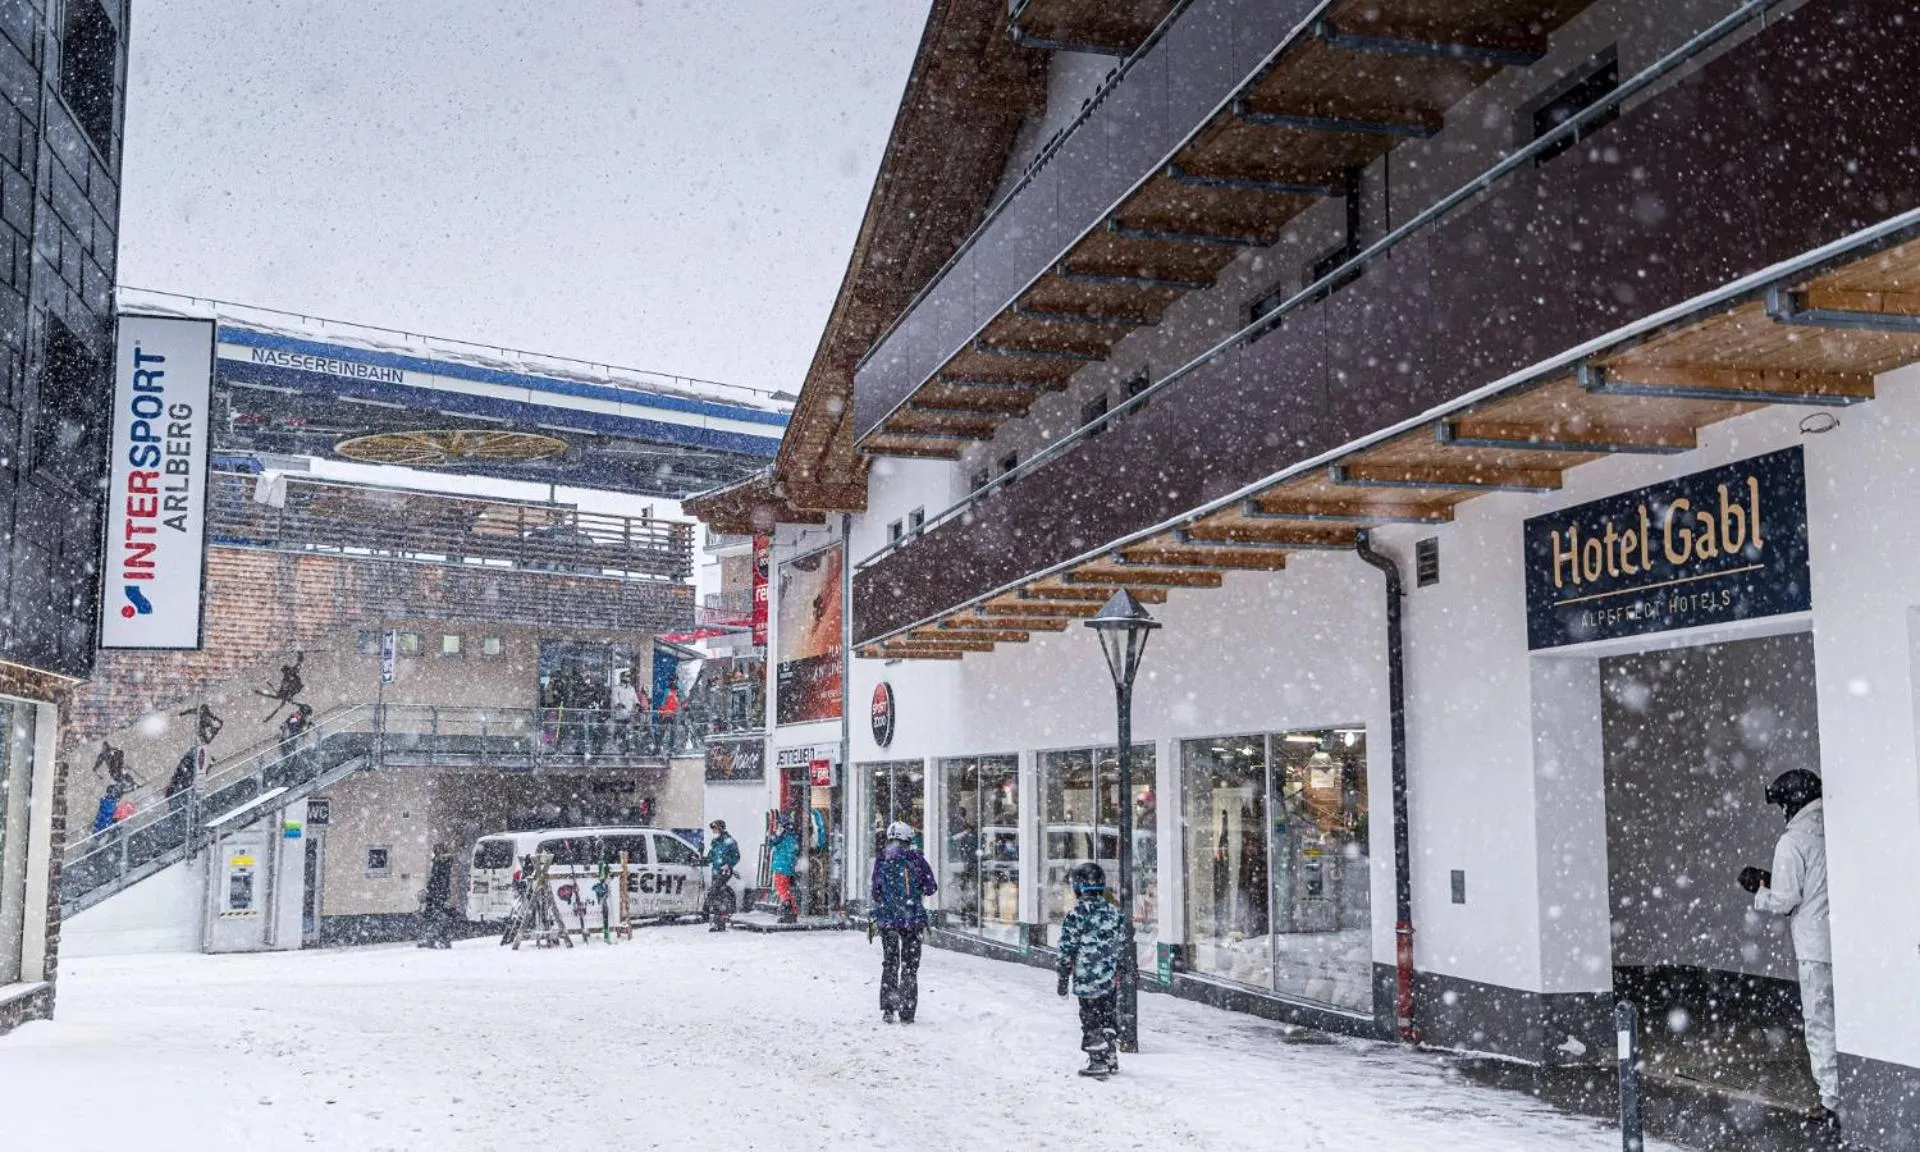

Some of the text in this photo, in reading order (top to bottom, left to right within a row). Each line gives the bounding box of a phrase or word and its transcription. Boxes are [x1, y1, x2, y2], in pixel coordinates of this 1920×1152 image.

[252, 348, 404, 383] NASSEREINBAHN
[123, 347, 166, 580] INTERSPORT
[163, 401, 193, 532] ARLBERG
[1551, 476, 1764, 588] Hotel Gabl
[1580, 589, 1732, 629] ALPEFFECT HOTELS
[308, 804, 329, 820] WC
